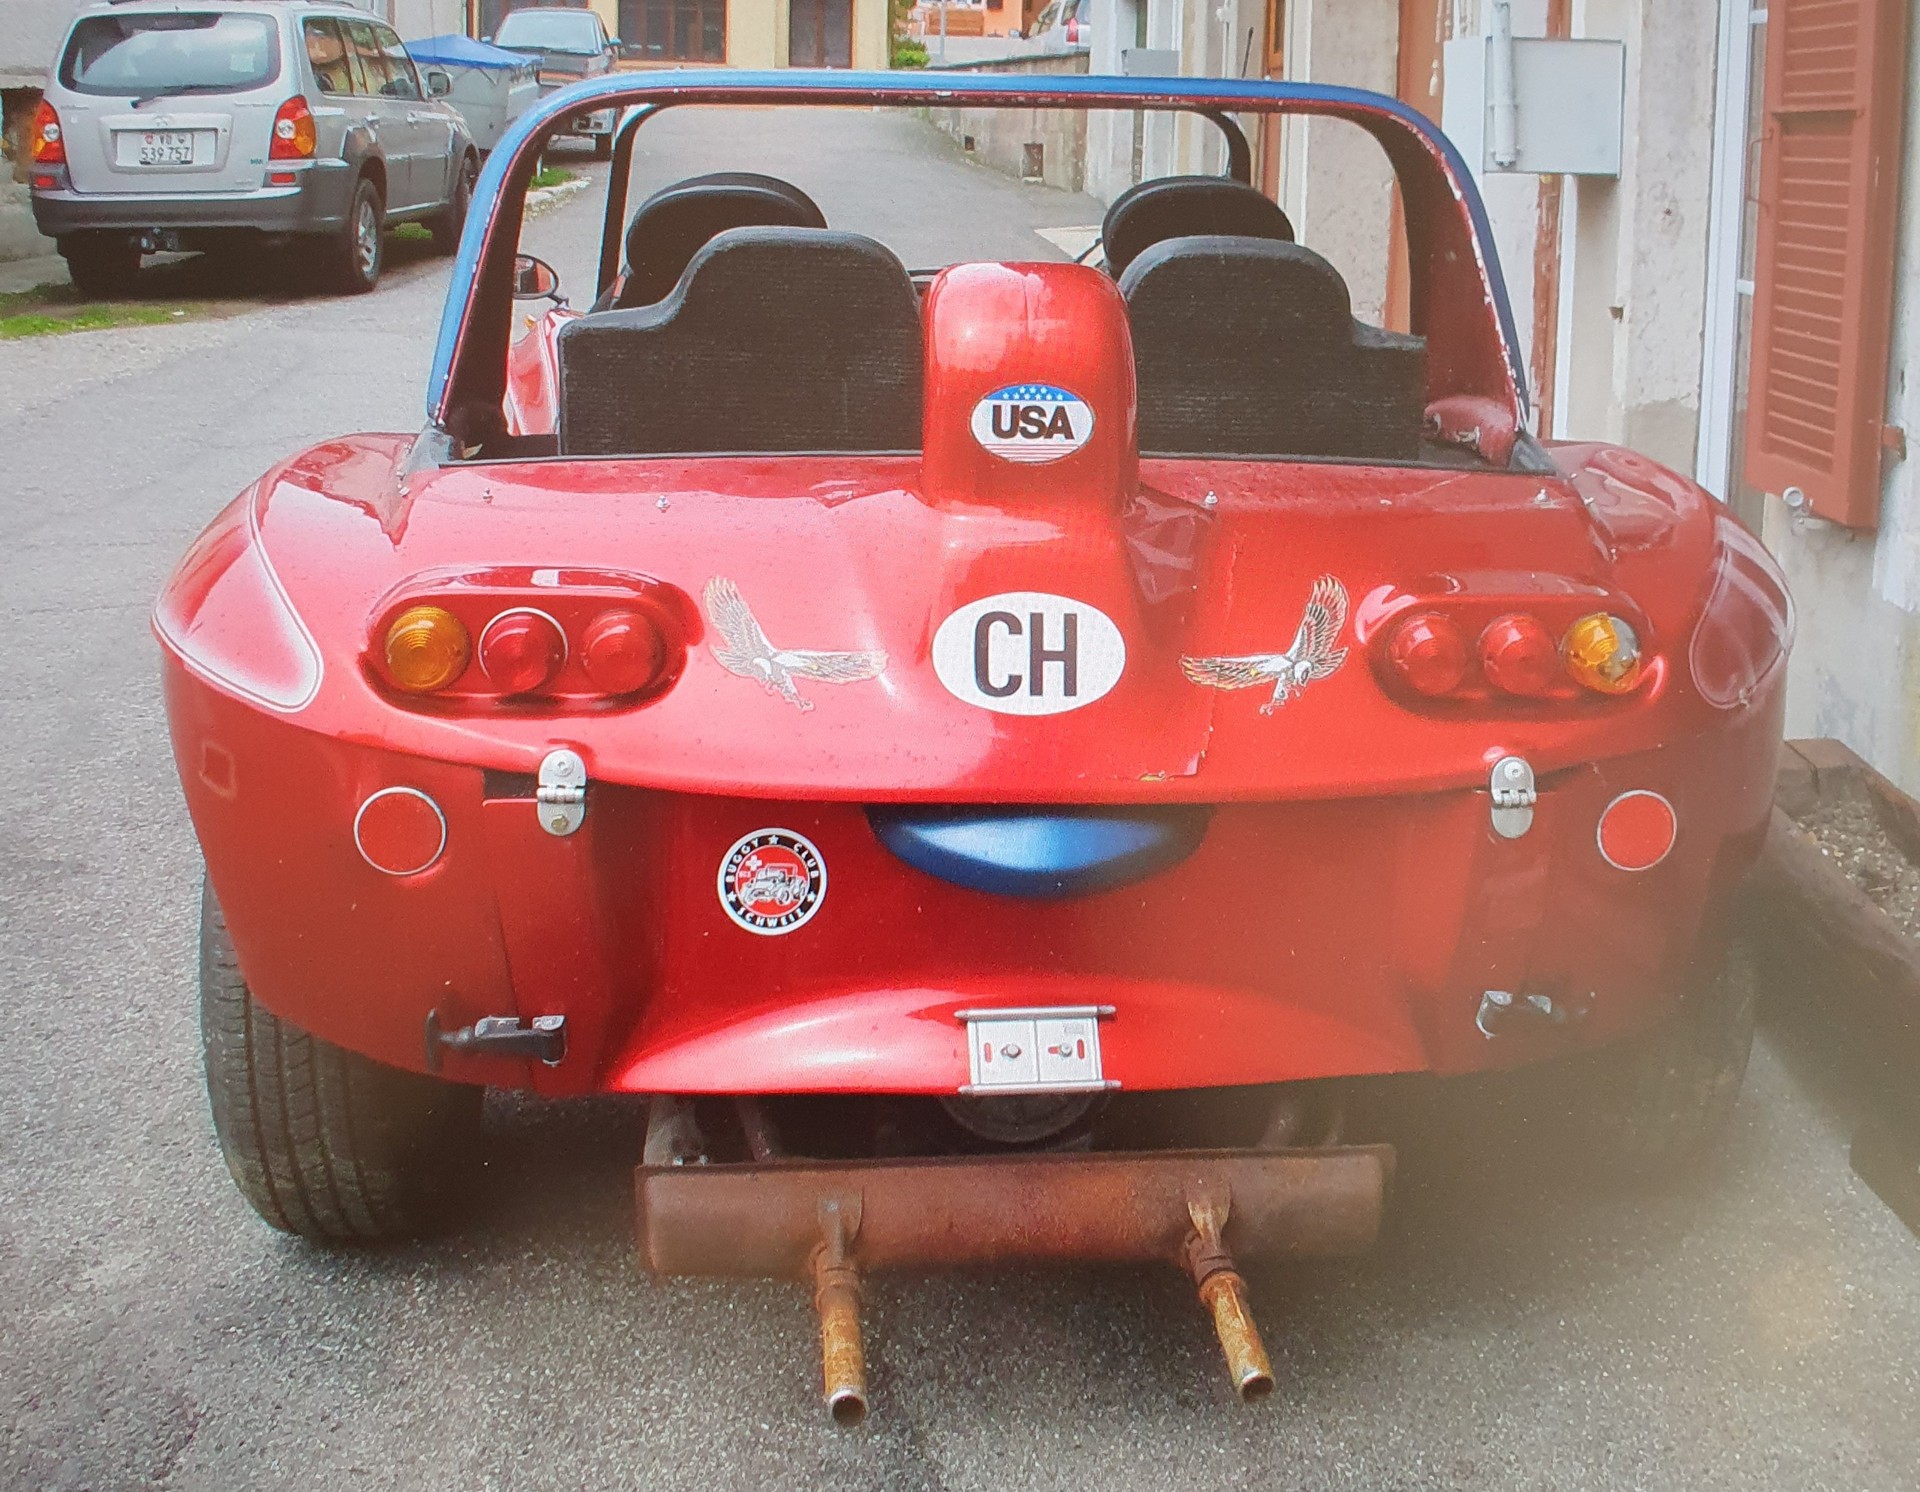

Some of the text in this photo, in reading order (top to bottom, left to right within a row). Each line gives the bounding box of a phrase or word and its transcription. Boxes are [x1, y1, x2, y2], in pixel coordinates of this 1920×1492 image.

[167, 146, 190, 160] 757
[992, 404, 1075, 440] USA
[974, 611, 1078, 698] CH
[725, 838, 820, 883] BUGGY CLUB
[736, 906, 805, 929] SCHWEIZ
